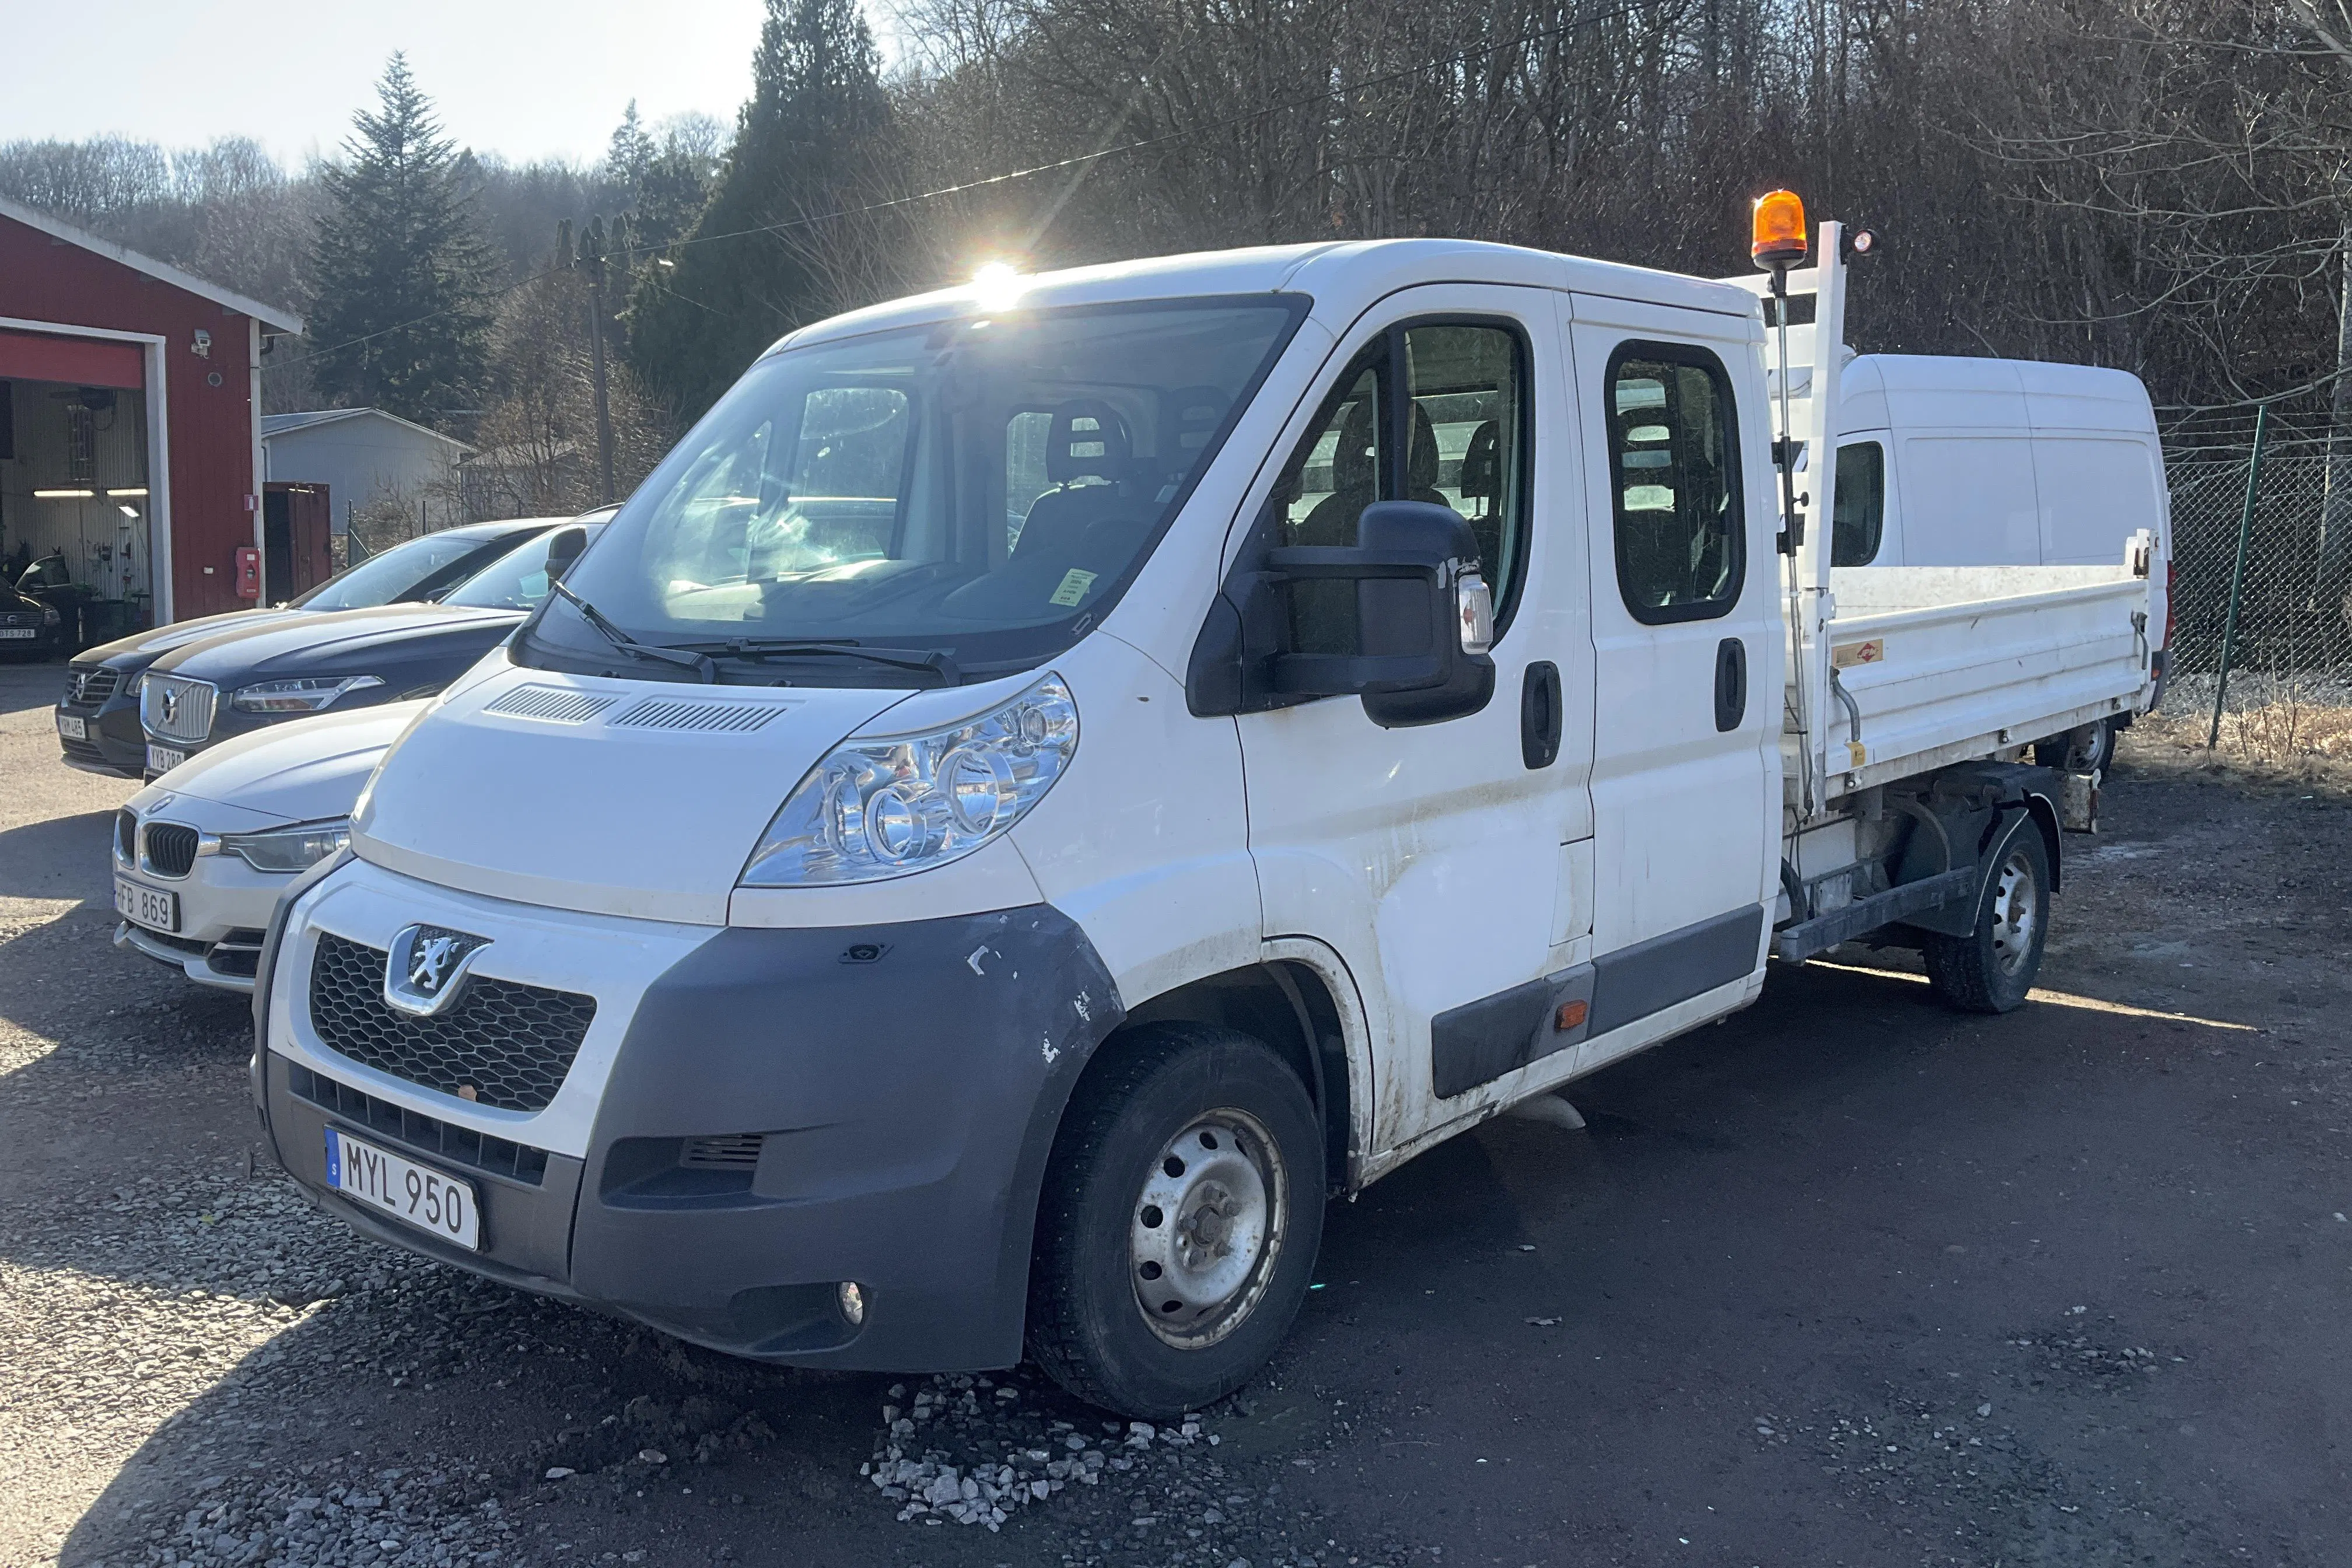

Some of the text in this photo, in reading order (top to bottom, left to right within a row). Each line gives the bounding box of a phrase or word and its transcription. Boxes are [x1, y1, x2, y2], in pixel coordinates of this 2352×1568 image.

[150, 747, 164, 769] YYB
[117, 881, 168, 925] HFB 869
[331, 1163, 337, 1176] S
[346, 1142, 461, 1234] MYL 950
